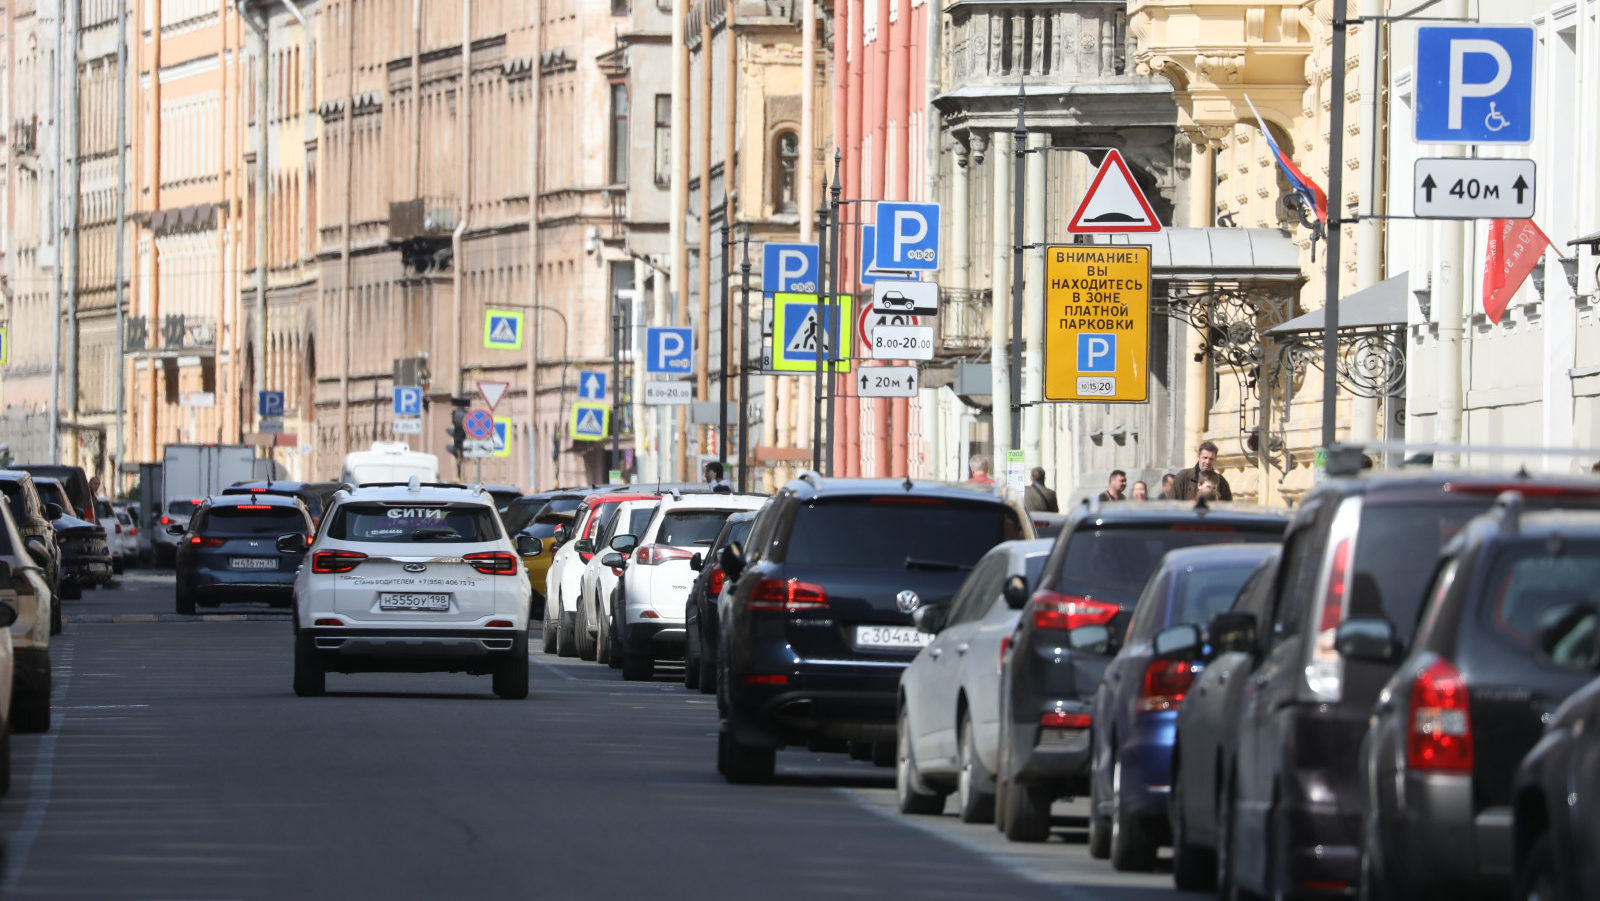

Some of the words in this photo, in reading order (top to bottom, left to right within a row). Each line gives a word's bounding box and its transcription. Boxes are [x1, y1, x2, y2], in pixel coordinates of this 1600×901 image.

[1448, 39, 1512, 129] P
[893, 210, 928, 262] P
[924, 250, 935, 259] 20
[1056, 251, 1138, 263] ВНИМАНИЕ!
[779, 249, 809, 292] P
[1087, 266, 1108, 276] ВЫ
[1052, 279, 1143, 291] НАХОДИТЕСЬ
[1072, 292, 1080, 303] В
[1086, 292, 1120, 303] ЗОНЕ
[1064, 302, 1129, 317] ПЛАТНОЙ
[1059, 318, 1134, 330] ПАРКОВКИ
[875, 336, 931, 349] 8.00-20.00
[659, 332, 684, 369] P
[1088, 337, 1109, 368] P
[1098, 382, 1111, 391] 20
[265, 393, 280, 414] P
[400, 389, 417, 412] P
[387, 508, 441, 519] СИТИ
[430, 595, 447, 604] 198
